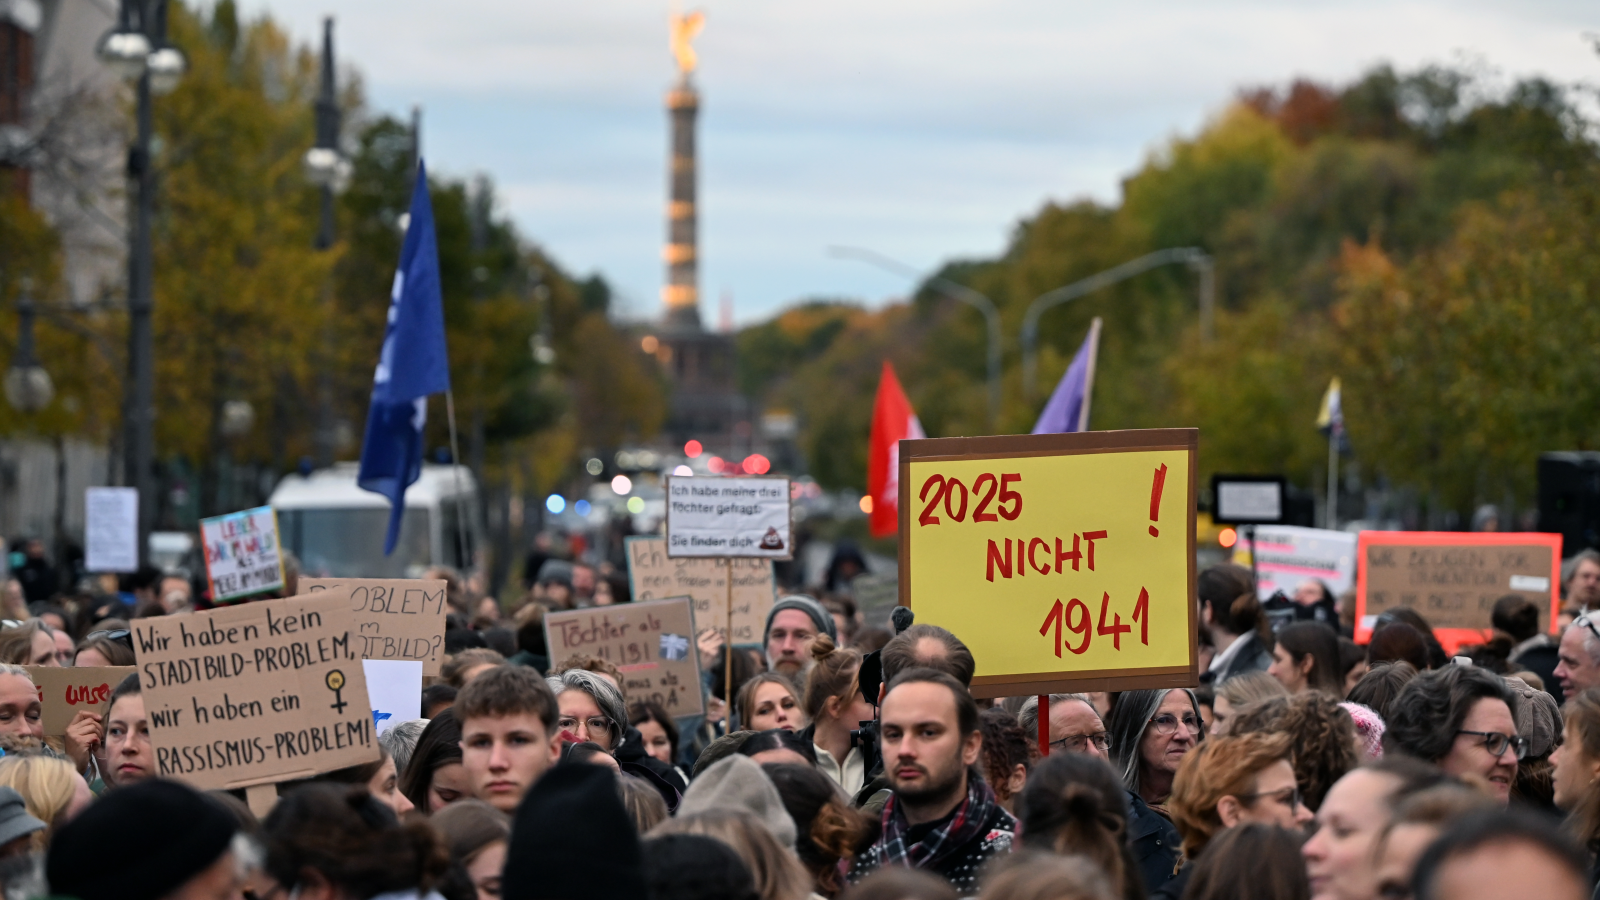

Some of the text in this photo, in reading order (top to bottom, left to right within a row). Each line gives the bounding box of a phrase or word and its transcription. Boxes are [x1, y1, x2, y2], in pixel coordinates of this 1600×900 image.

[671, 485, 781, 498] Ich habe meine drei
[671, 501, 714, 514] Töchter
[918, 472, 1023, 527] 2025
[1148, 462, 1168, 538] !
[671, 534, 754, 548] Sie finden dich
[985, 529, 1108, 582] NICHT
[310, 585, 444, 614] OBLEM
[136, 607, 322, 654] Wir haben kein
[550, 614, 630, 648] Töchter
[639, 613, 662, 632] als
[1038, 586, 1149, 659] 1941
[143, 631, 355, 689] STADTBILD-PROBLEM,
[150, 689, 301, 729] wir haben ein
[156, 717, 372, 776] RASSISMUS-PROBLEM!
